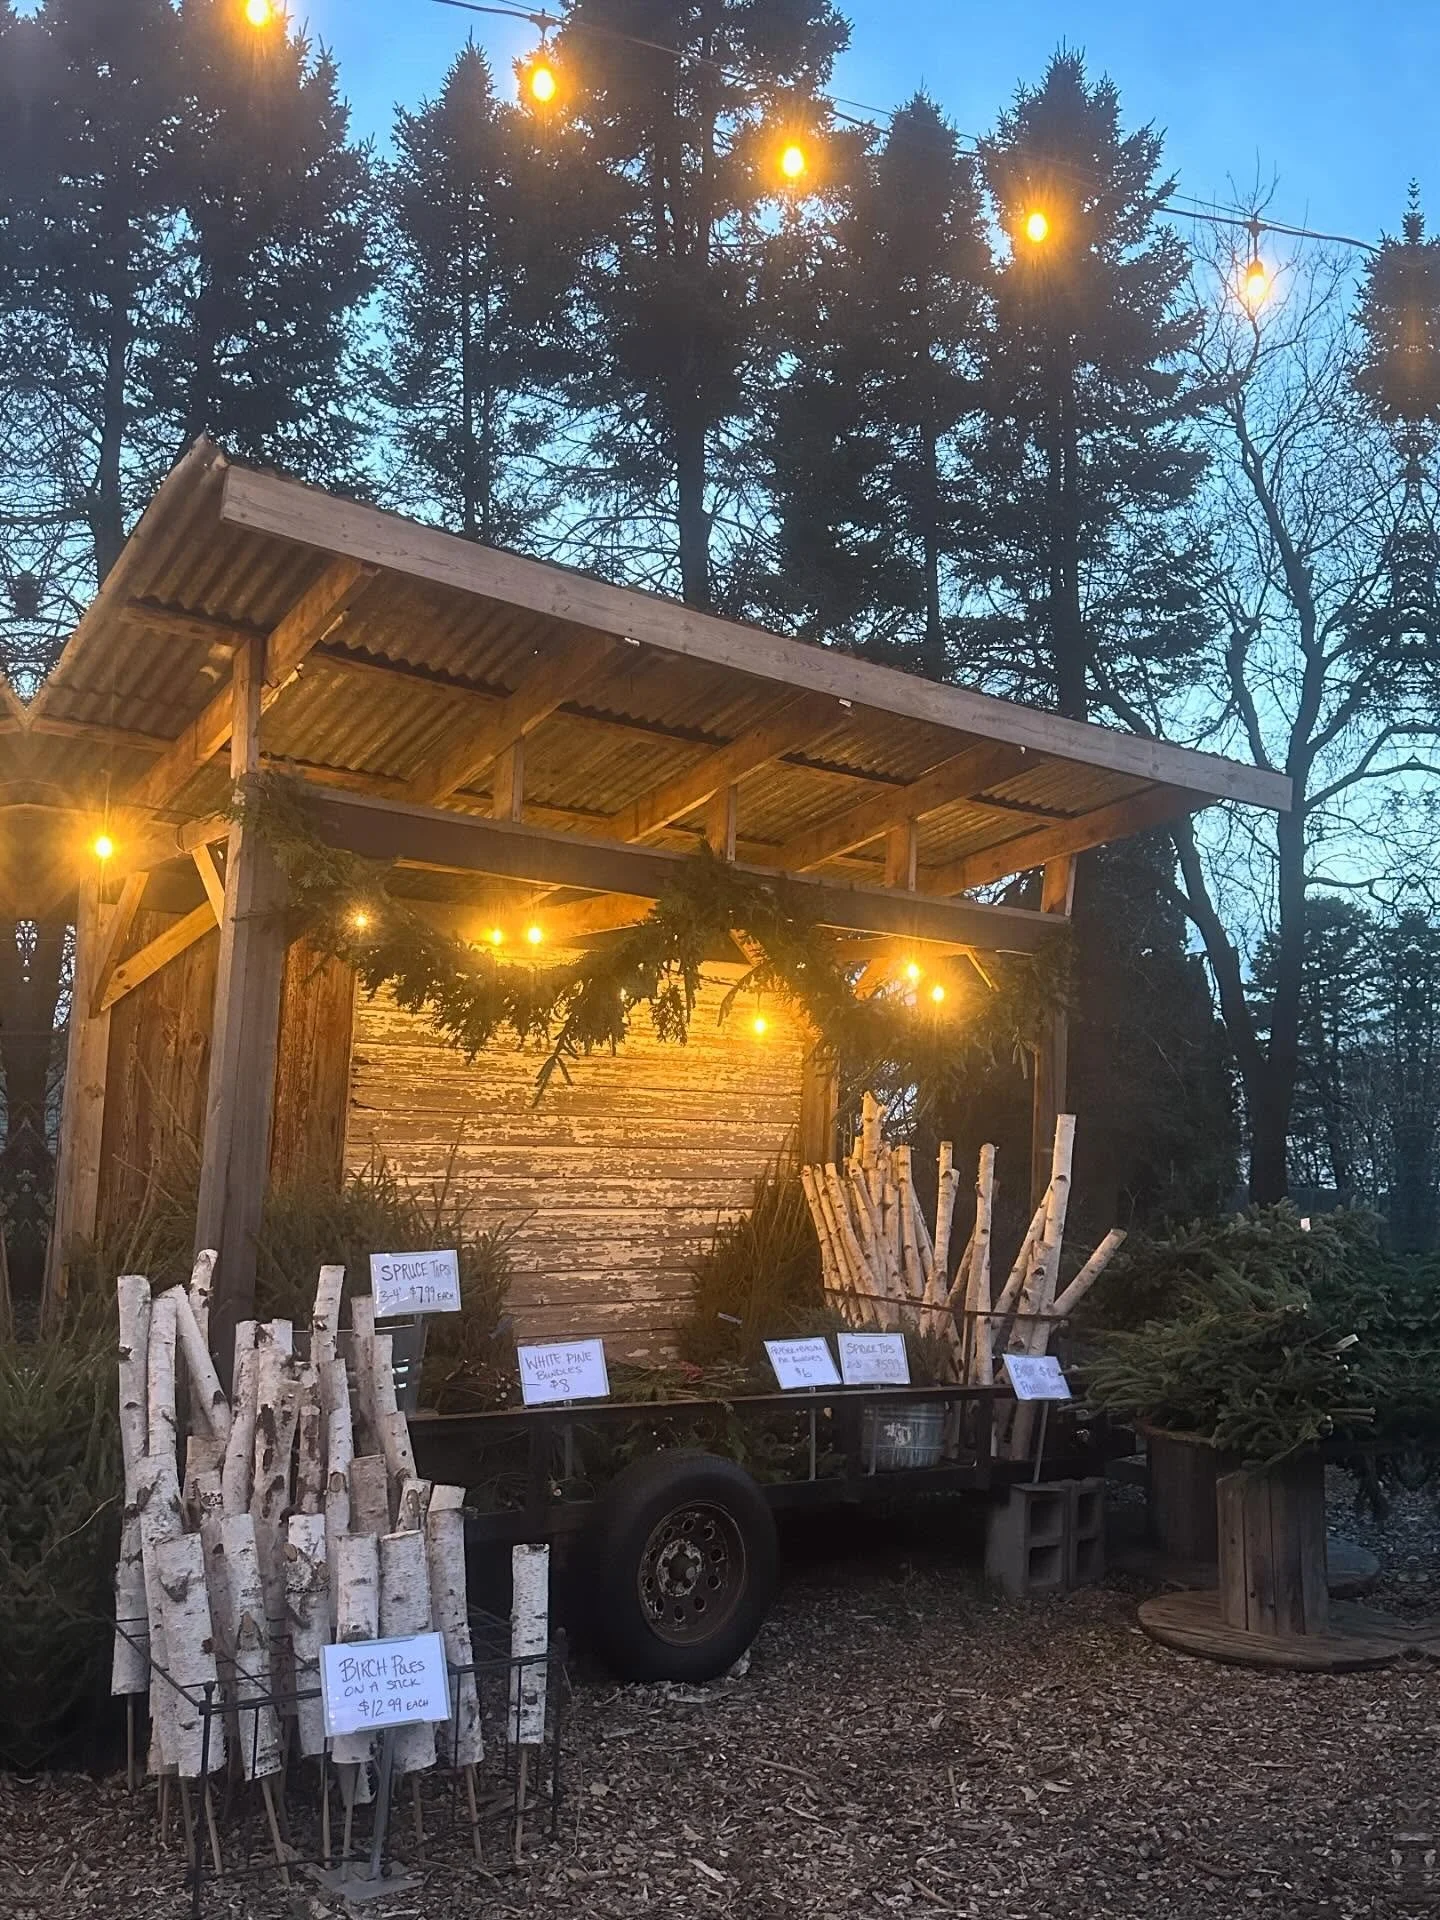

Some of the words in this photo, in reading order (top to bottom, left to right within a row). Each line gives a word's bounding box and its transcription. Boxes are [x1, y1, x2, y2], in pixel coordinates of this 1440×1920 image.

[381, 1261, 428, 1281] SPRUCE
[430, 1259, 452, 1278] TIPS
[525, 1352, 561, 1371] WHITE
[566, 1350, 592, 1364] PINE
[536, 1366, 583, 1381] BUNDLES
[549, 1378, 570, 1393] $8
[338, 1656, 388, 1683] BIRCH
[391, 1654, 426, 1678] POLES
[344, 1684, 365, 1697] ON
[369, 1681, 379, 1693] A
[386, 1678, 421, 1691] STICK
[406, 1699, 429, 1711] EACH
